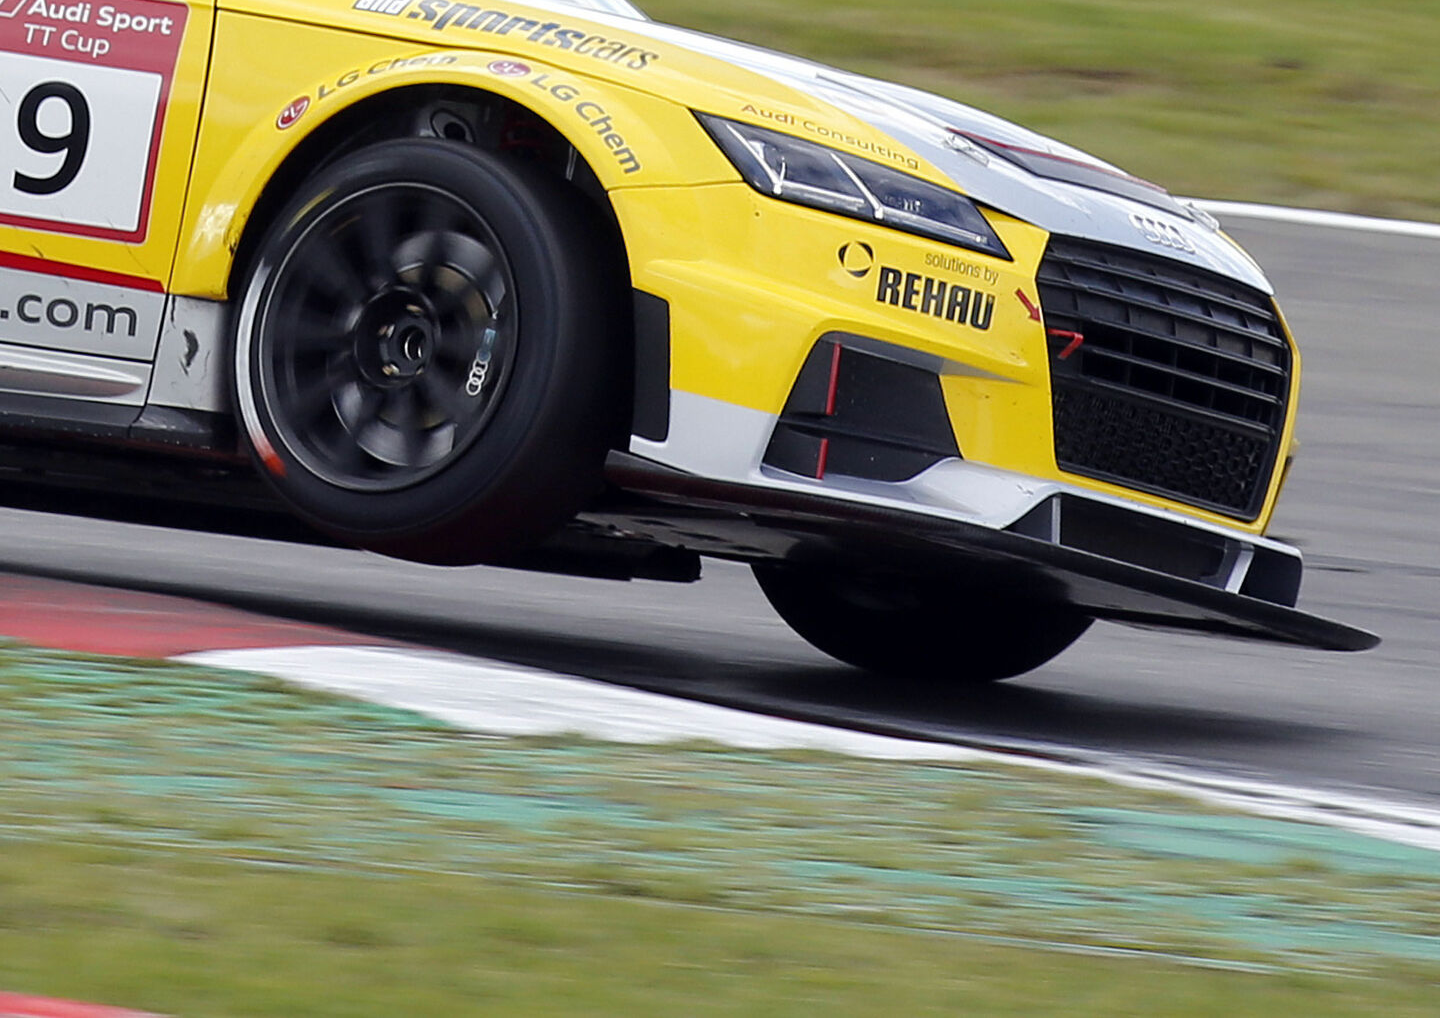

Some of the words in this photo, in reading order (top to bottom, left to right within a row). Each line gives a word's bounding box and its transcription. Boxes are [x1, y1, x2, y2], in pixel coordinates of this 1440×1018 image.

[24, 23, 57, 46] TT
[61, 30, 111, 59] Cup
[96, 6, 174, 35] Sport
[318, 70, 360, 100] LG
[367, 55, 458, 76] Chem
[13, 81, 92, 196] 9
[529, 73, 580, 102] LG
[575, 101, 642, 175] Chem
[741, 104, 796, 124] Audi
[803, 120, 920, 171] Consulting
[925, 252, 981, 279] solutions
[983, 265, 1000, 286] by
[876, 266, 996, 332] REHAU
